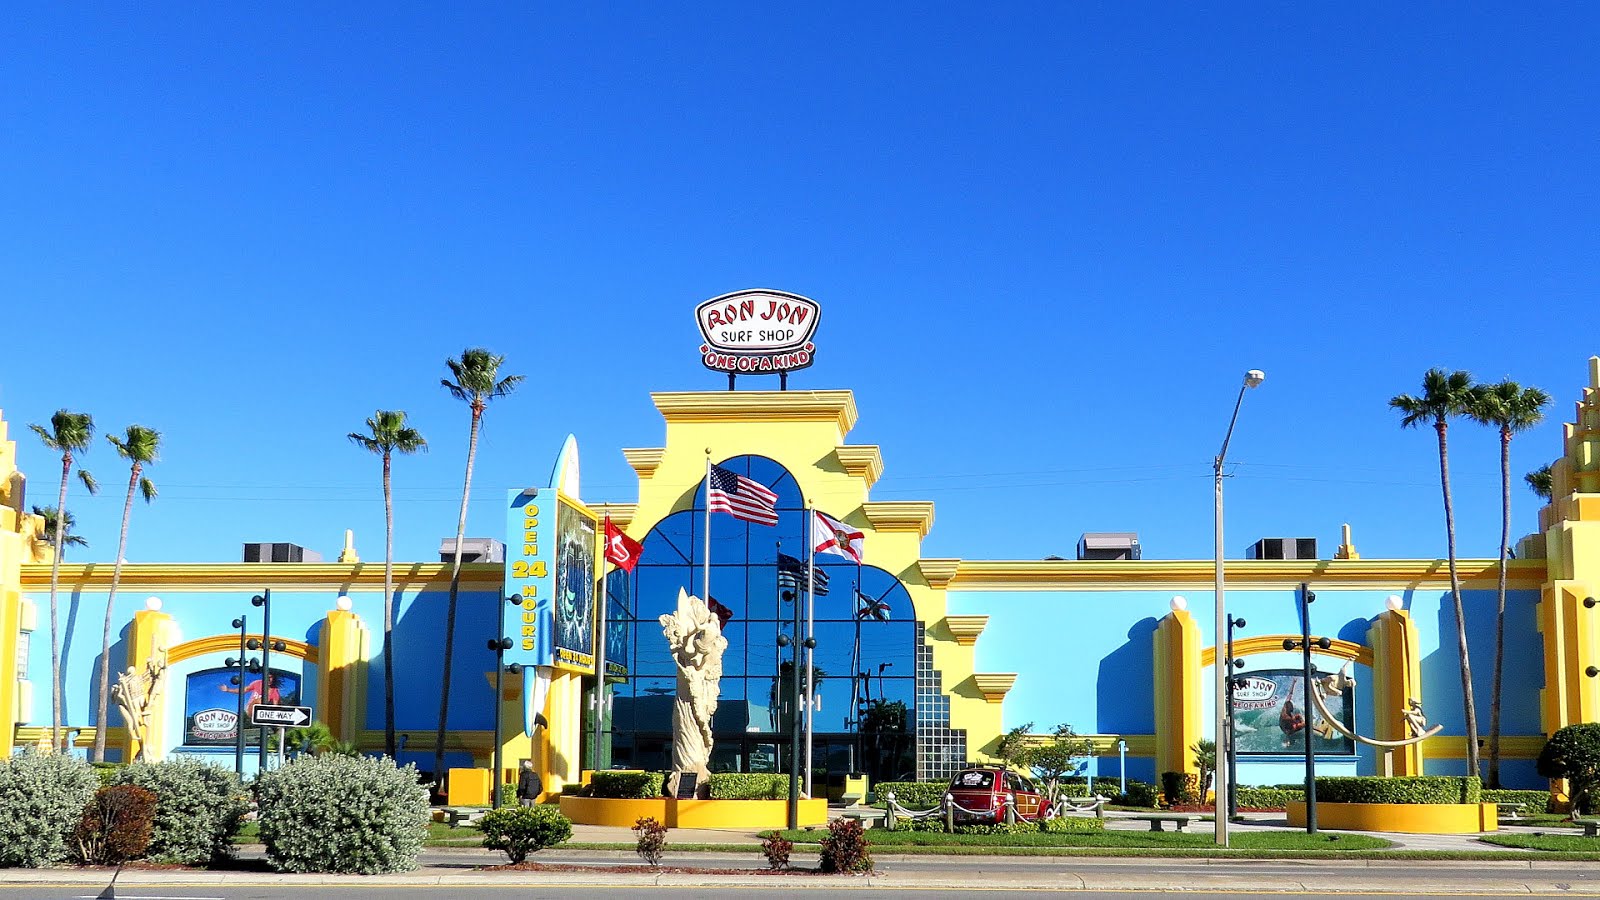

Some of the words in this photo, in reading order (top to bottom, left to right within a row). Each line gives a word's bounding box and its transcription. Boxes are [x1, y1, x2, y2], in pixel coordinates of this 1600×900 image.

[708, 300, 754, 330] RON
[760, 301, 809, 325] JON
[721, 330, 753, 342] SURF
[759, 329, 794, 341] SHOP
[738, 356, 759, 370] OF
[760, 357, 772, 370] A
[523, 504, 540, 556] OPEN
[512, 560, 548, 578] 24
[521, 585, 537, 651] HOURS
[1253, 681, 1273, 691] JON
[198, 712, 216, 724] RON
[217, 713, 236, 723] JON
[259, 710, 275, 719] ONE
